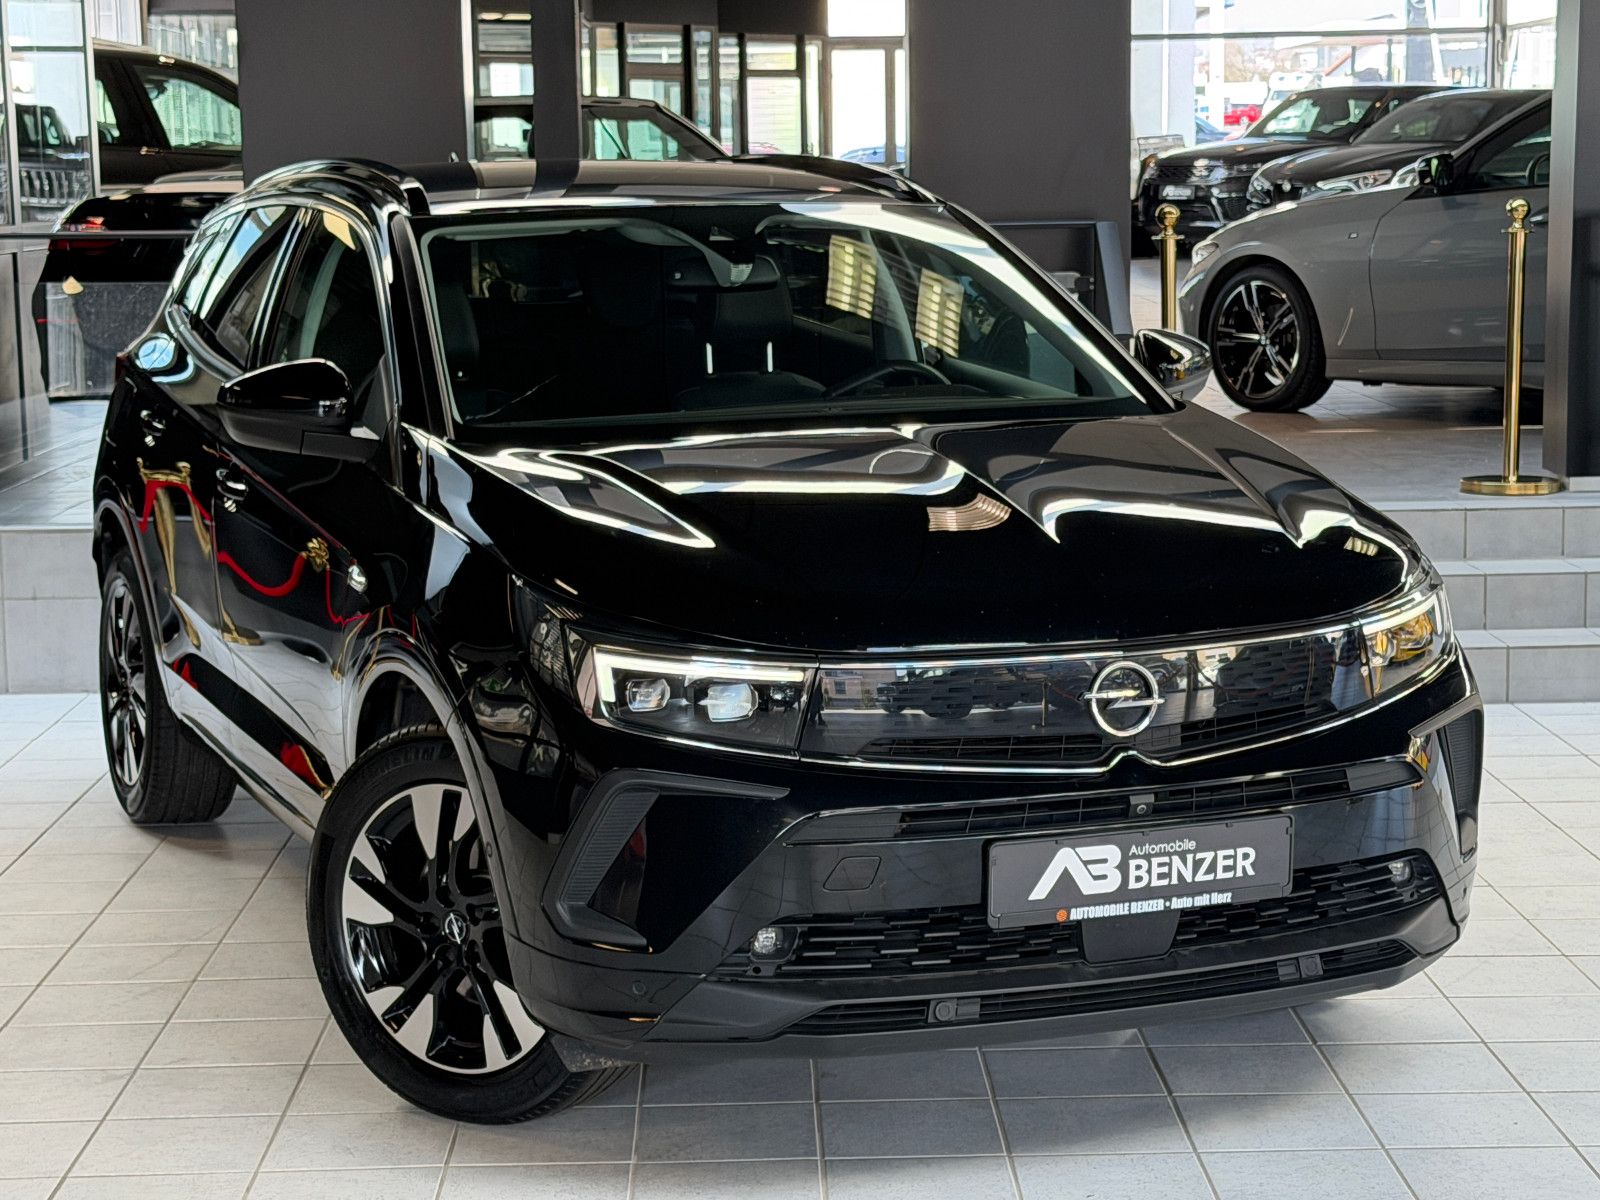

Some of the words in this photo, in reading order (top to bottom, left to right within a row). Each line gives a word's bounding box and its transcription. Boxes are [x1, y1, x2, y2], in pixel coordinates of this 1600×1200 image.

[1128, 838, 1196, 857] Automobile
[1127, 847, 1256, 890] BENZER
[1069, 905, 1130, 921] AUTOMOBILE
[1130, 899, 1165, 914] BENZER
[1170, 896, 1193, 910] Auto
[1193, 894, 1210, 907] mit
[1210, 892, 1233, 905] Herz
